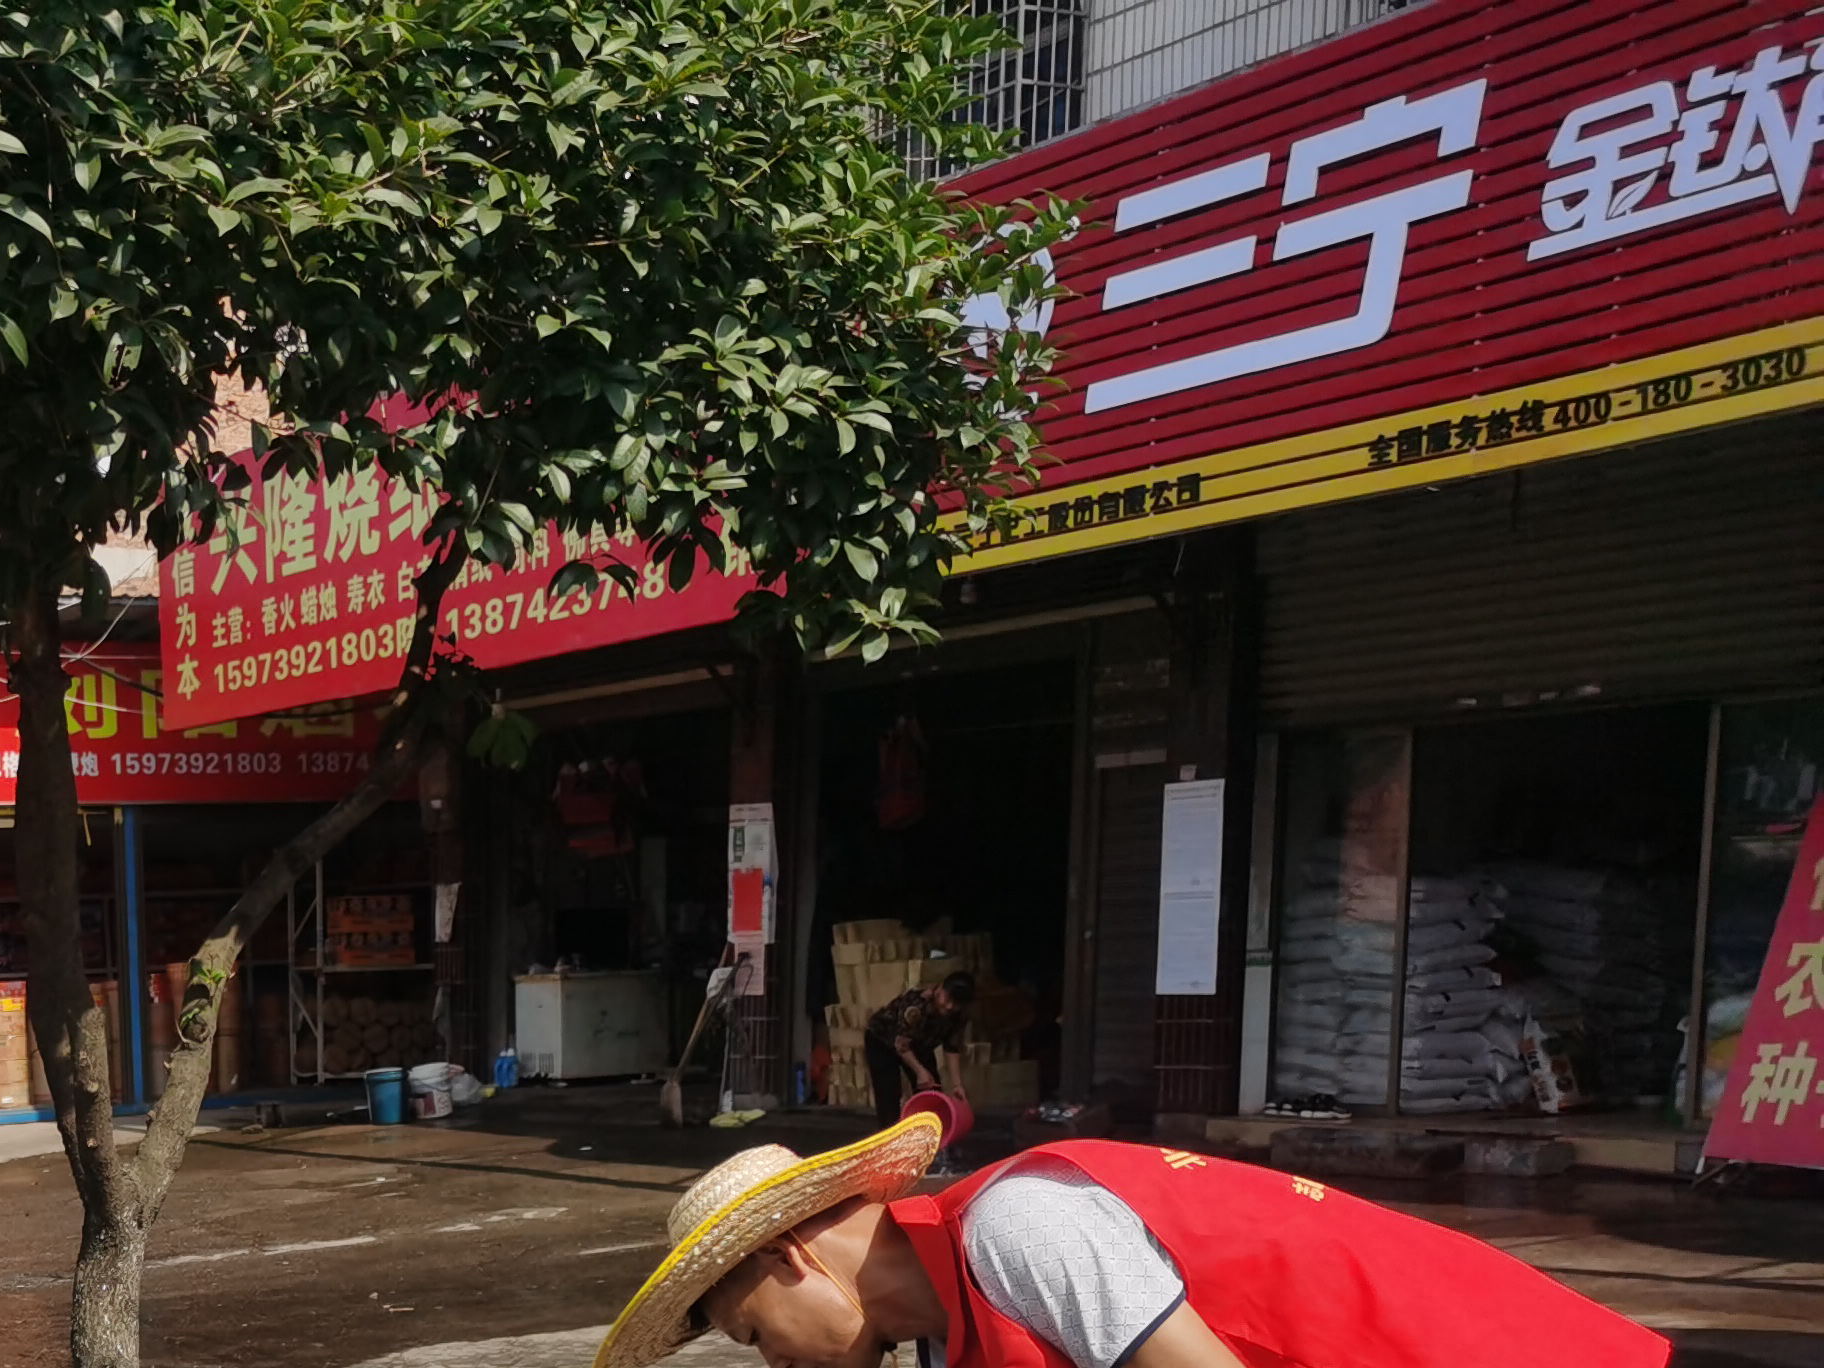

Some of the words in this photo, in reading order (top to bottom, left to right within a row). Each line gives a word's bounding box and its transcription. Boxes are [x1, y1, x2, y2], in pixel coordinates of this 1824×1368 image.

[1084, 78, 1487, 414] 三宁
[1367, 400, 1547, 467] 全国服务热线
[1552, 347, 1809, 428] 400-180-3030
[262, 594, 296, 636] 香火
[300, 580, 337, 626] 蜡烛
[347, 568, 386, 615] 寿衣
[111, 751, 282, 776] 15973921803
[1740, 1040, 1824, 1128] 种
